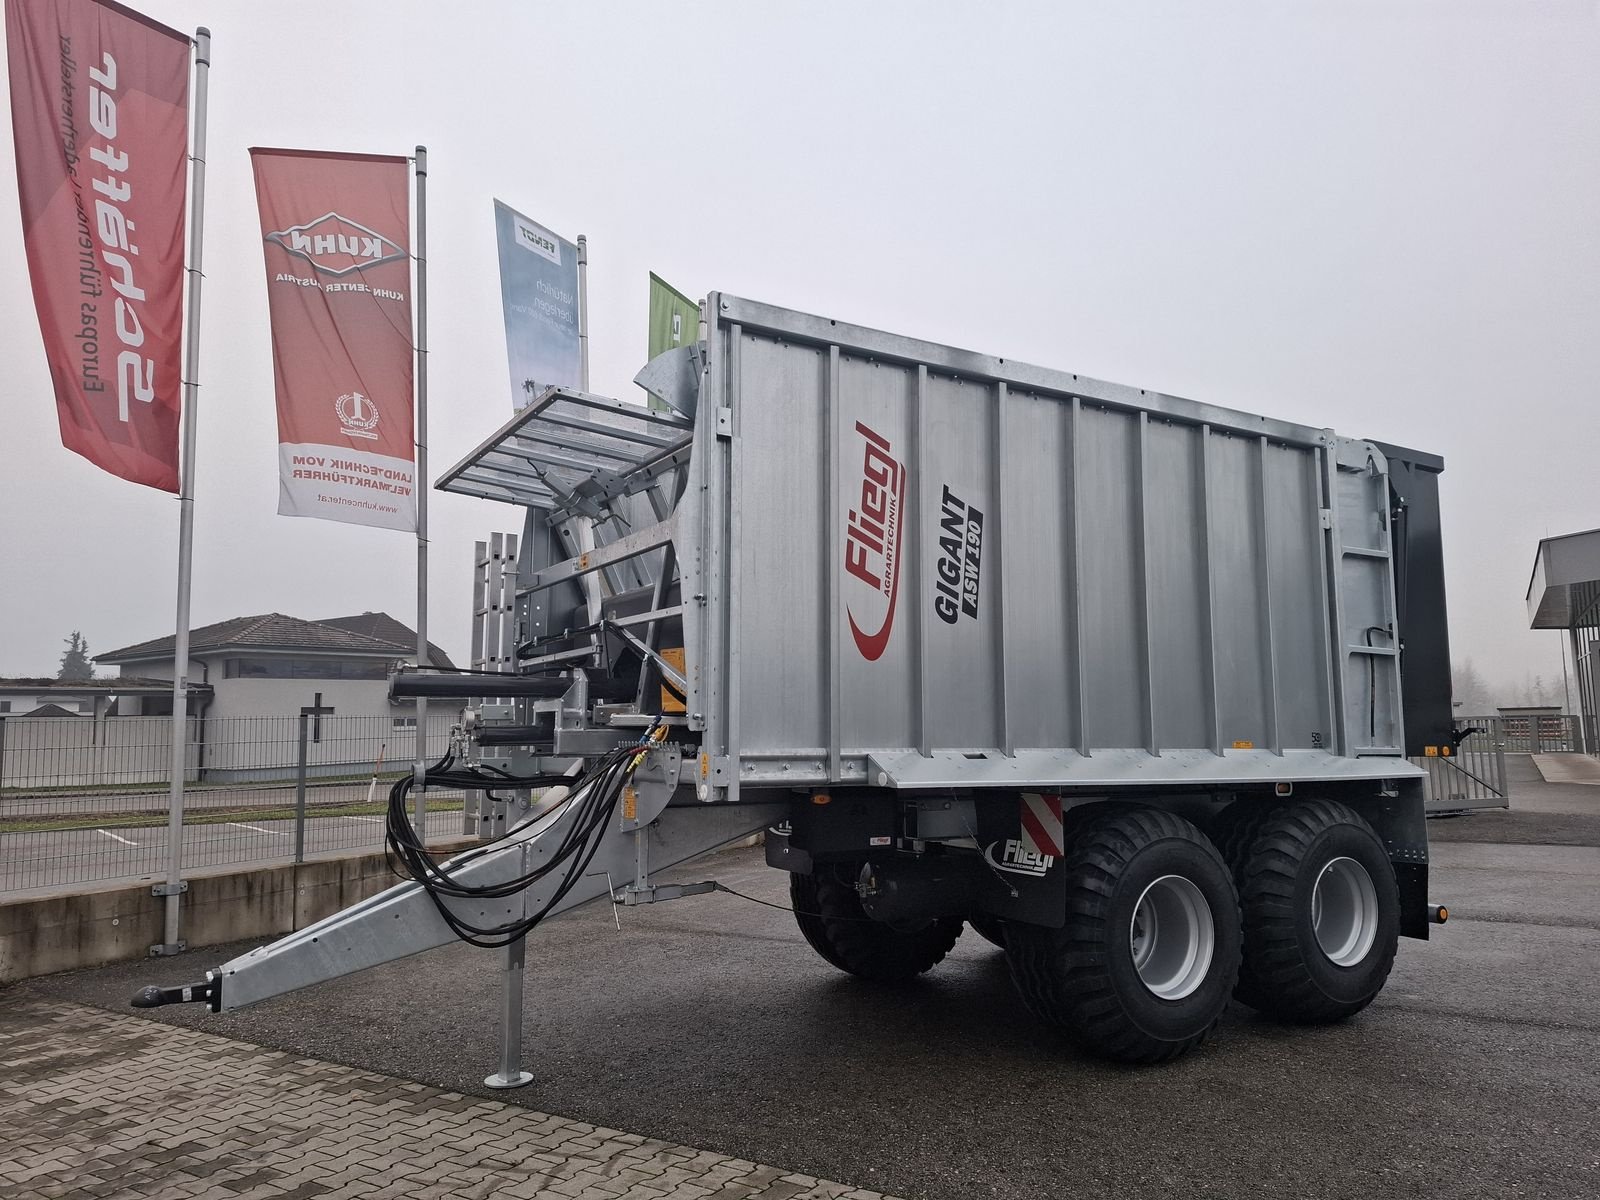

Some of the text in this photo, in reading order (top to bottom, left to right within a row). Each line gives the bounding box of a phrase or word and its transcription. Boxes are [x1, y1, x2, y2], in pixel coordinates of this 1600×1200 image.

[845, 420, 898, 591] Fliegl
[883, 497, 897, 598] AGRARTECHNIK
[935, 484, 966, 625] GIGANT
[964, 520, 981, 608] ASW 190
